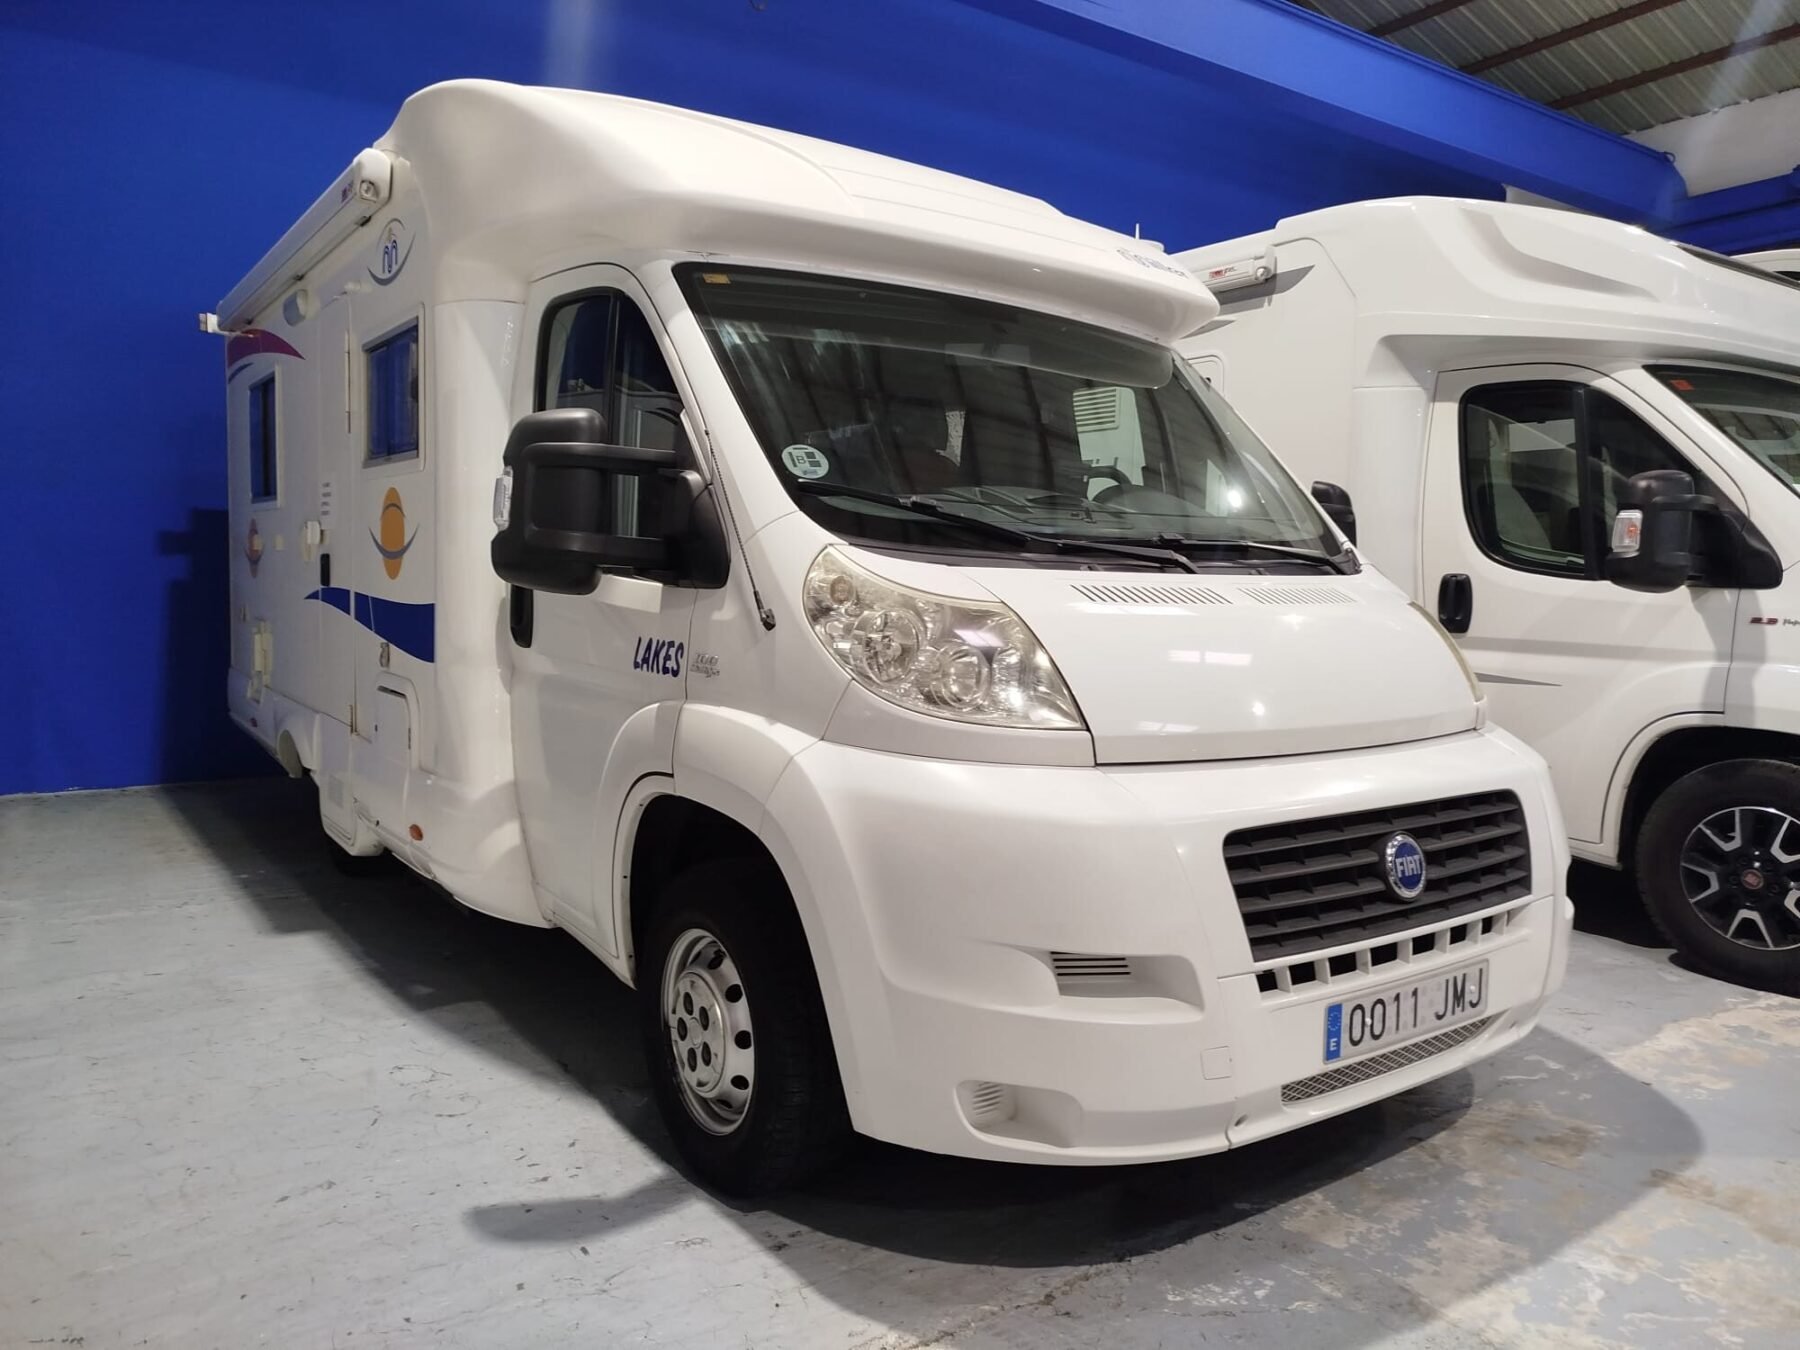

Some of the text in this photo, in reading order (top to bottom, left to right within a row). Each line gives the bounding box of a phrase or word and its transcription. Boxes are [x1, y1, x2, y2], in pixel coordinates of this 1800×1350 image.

[633, 636, 684, 678] LAKES
[1395, 854, 1422, 878] FIAT
[1349, 968, 1483, 1047] 0011 JMJ
[1329, 1038, 1338, 1051] E
